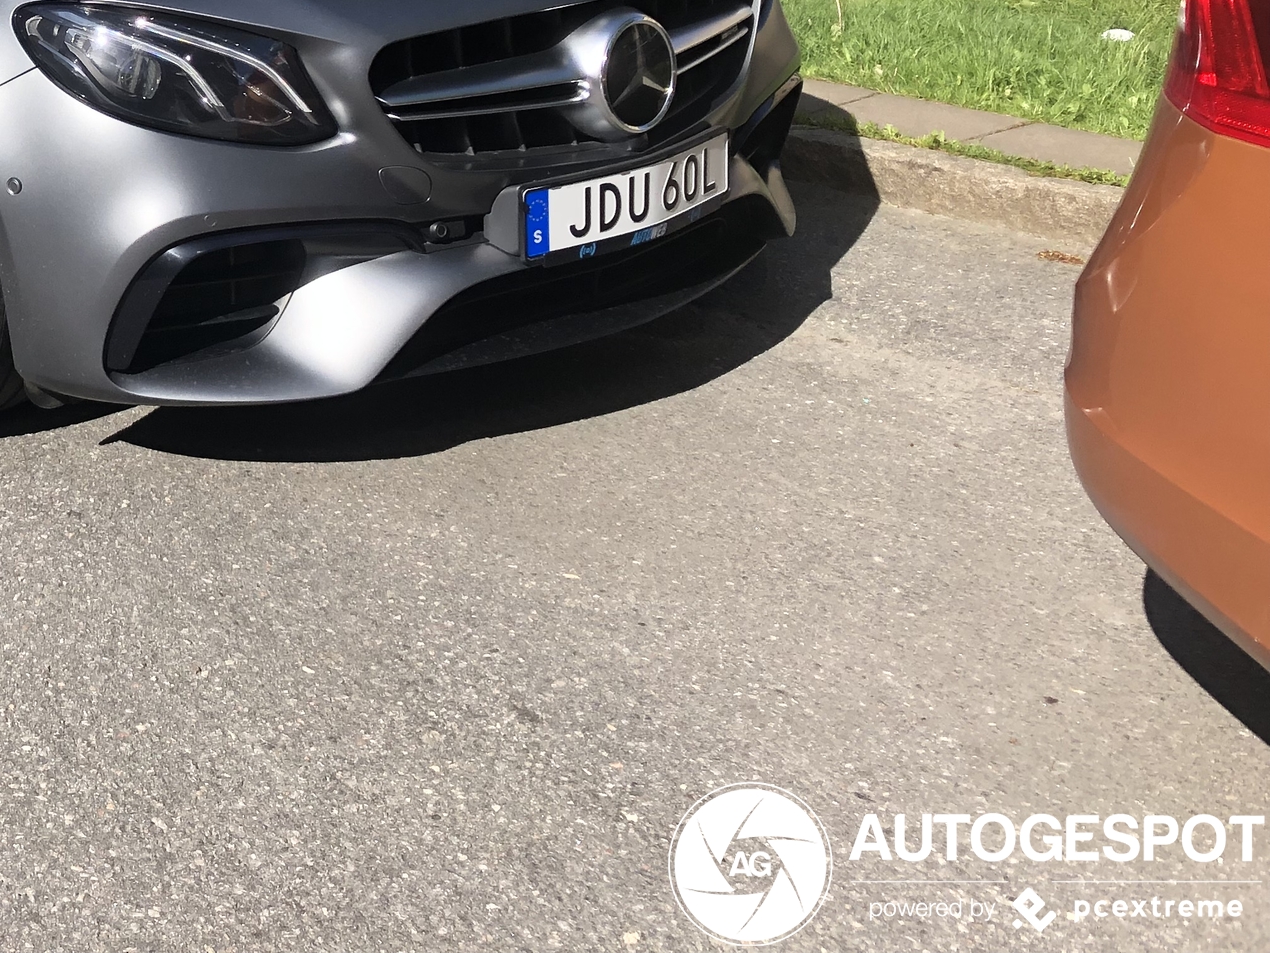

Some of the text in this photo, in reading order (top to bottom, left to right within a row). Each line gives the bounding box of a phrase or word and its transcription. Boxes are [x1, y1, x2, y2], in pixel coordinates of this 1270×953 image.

[569, 148, 716, 238] JDU 60L
[533, 229, 543, 244] S
